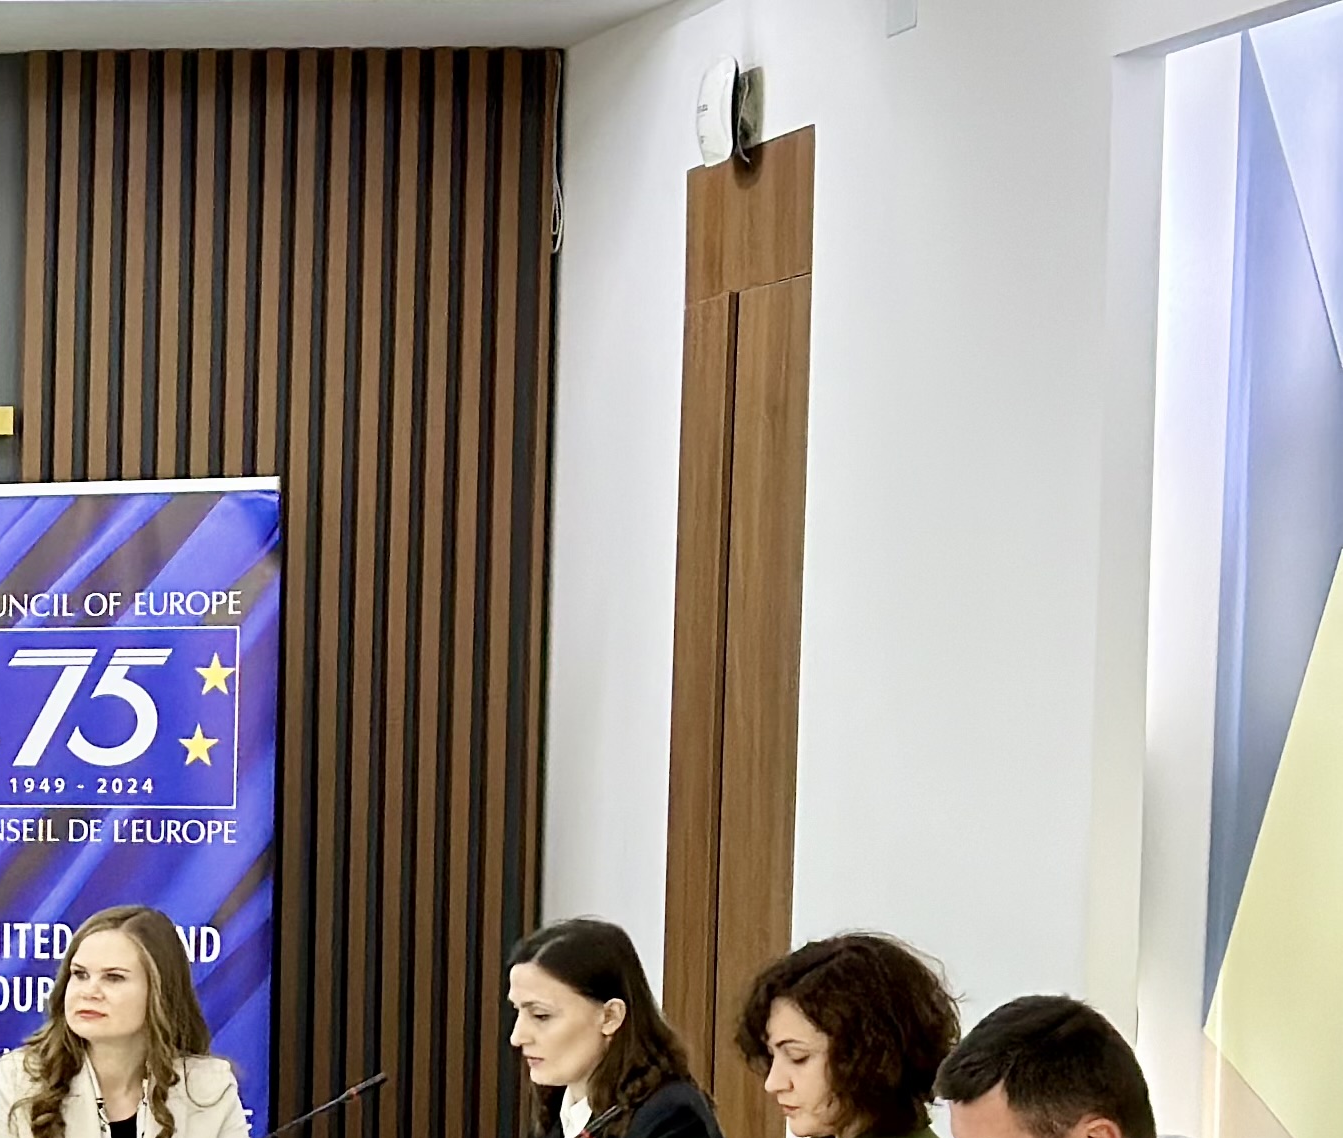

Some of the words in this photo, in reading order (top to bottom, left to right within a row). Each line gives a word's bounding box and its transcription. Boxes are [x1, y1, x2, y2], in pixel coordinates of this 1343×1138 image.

[84, 592, 122, 617] OF
[133, 590, 243, 616] EUROPE
[8, 647, 174, 767] 75
[9, 777, 67, 795] 1949
[96, 777, 155, 795] 2024
[68, 819, 103, 842] DE
[113, 818, 238, 844] L'EUROPE
